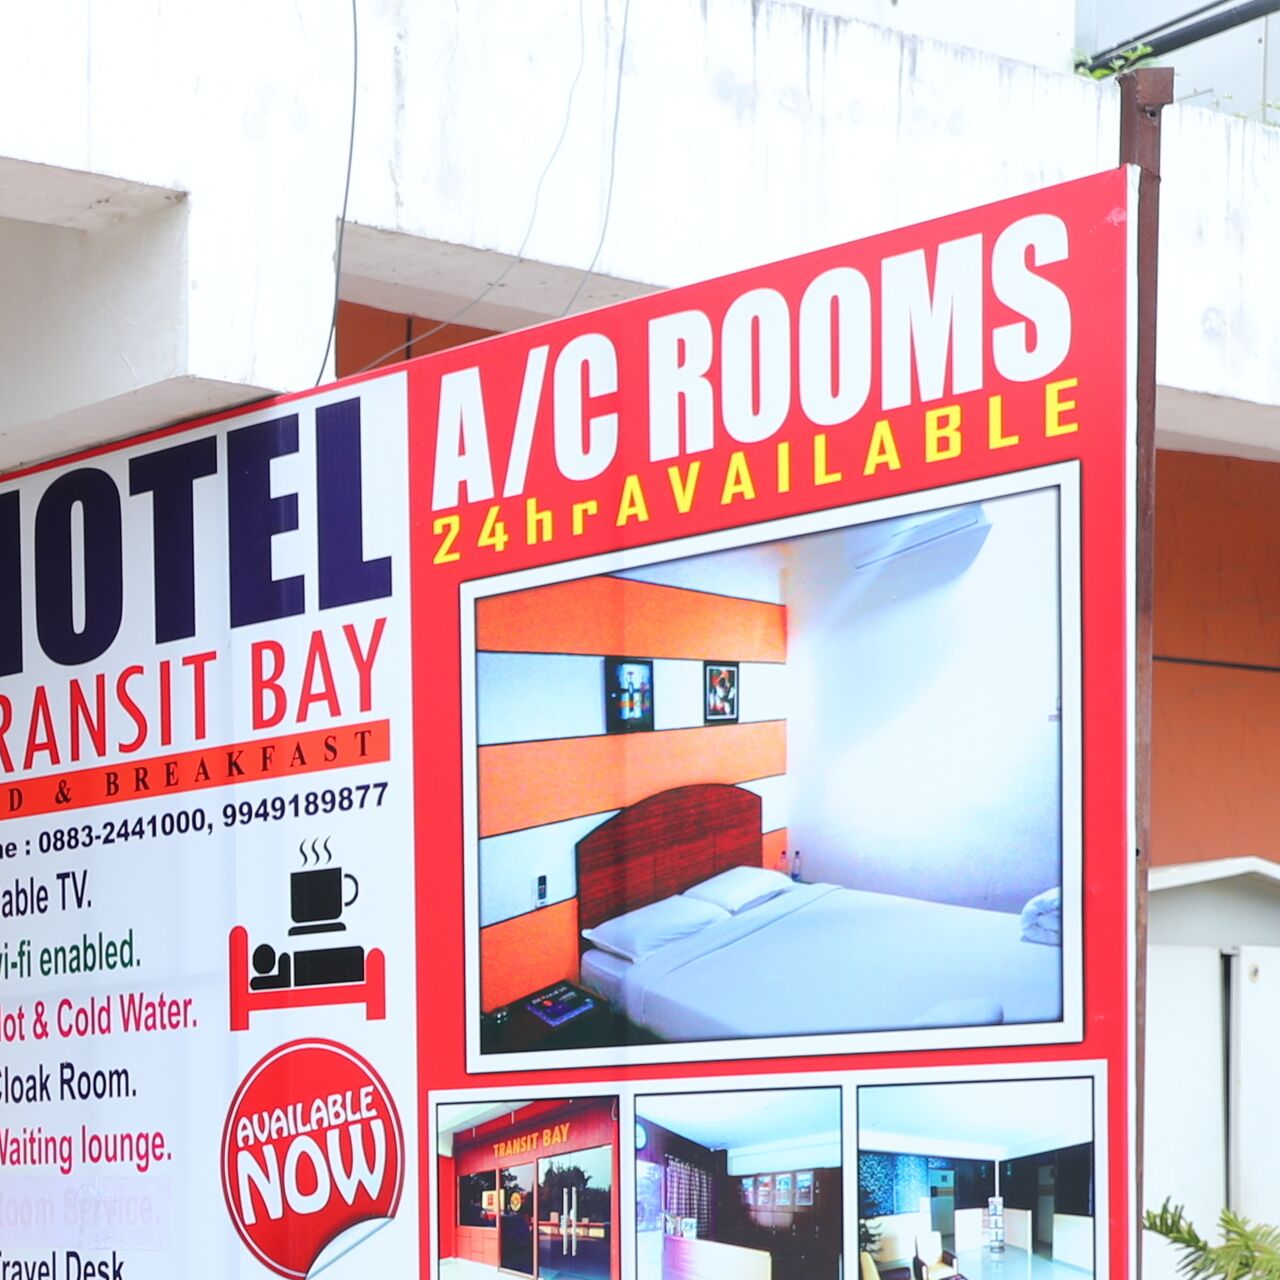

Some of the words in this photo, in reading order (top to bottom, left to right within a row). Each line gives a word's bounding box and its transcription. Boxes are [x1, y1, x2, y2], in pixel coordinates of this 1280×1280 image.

[432, 332, 618, 512] A/C
[649, 213, 1072, 463] ROOMS
[251, 617, 388, 730] BAY
[54, 779, 72, 805] &
[106, 730, 372, 796] BREAKFAST
[39, 808, 214, 854] 0883-2441000,
[223, 782, 389, 828] 9949189877
[56, 869, 92, 911] TV.
[40, 929, 141, 976] enabled.
[33, 1002, 49, 1040] &
[57, 997, 111, 1037] Cold
[119, 993, 197, 1032] Water.
[59, 1061, 137, 1100] Room.
[236, 1085, 378, 1149] AVAILABLE
[493, 1132, 539, 1159] TRANSIT
[542, 1122, 570, 1147] BAY
[81, 1125, 172, 1172] lounge.
[236, 1119, 387, 1225] NOW
